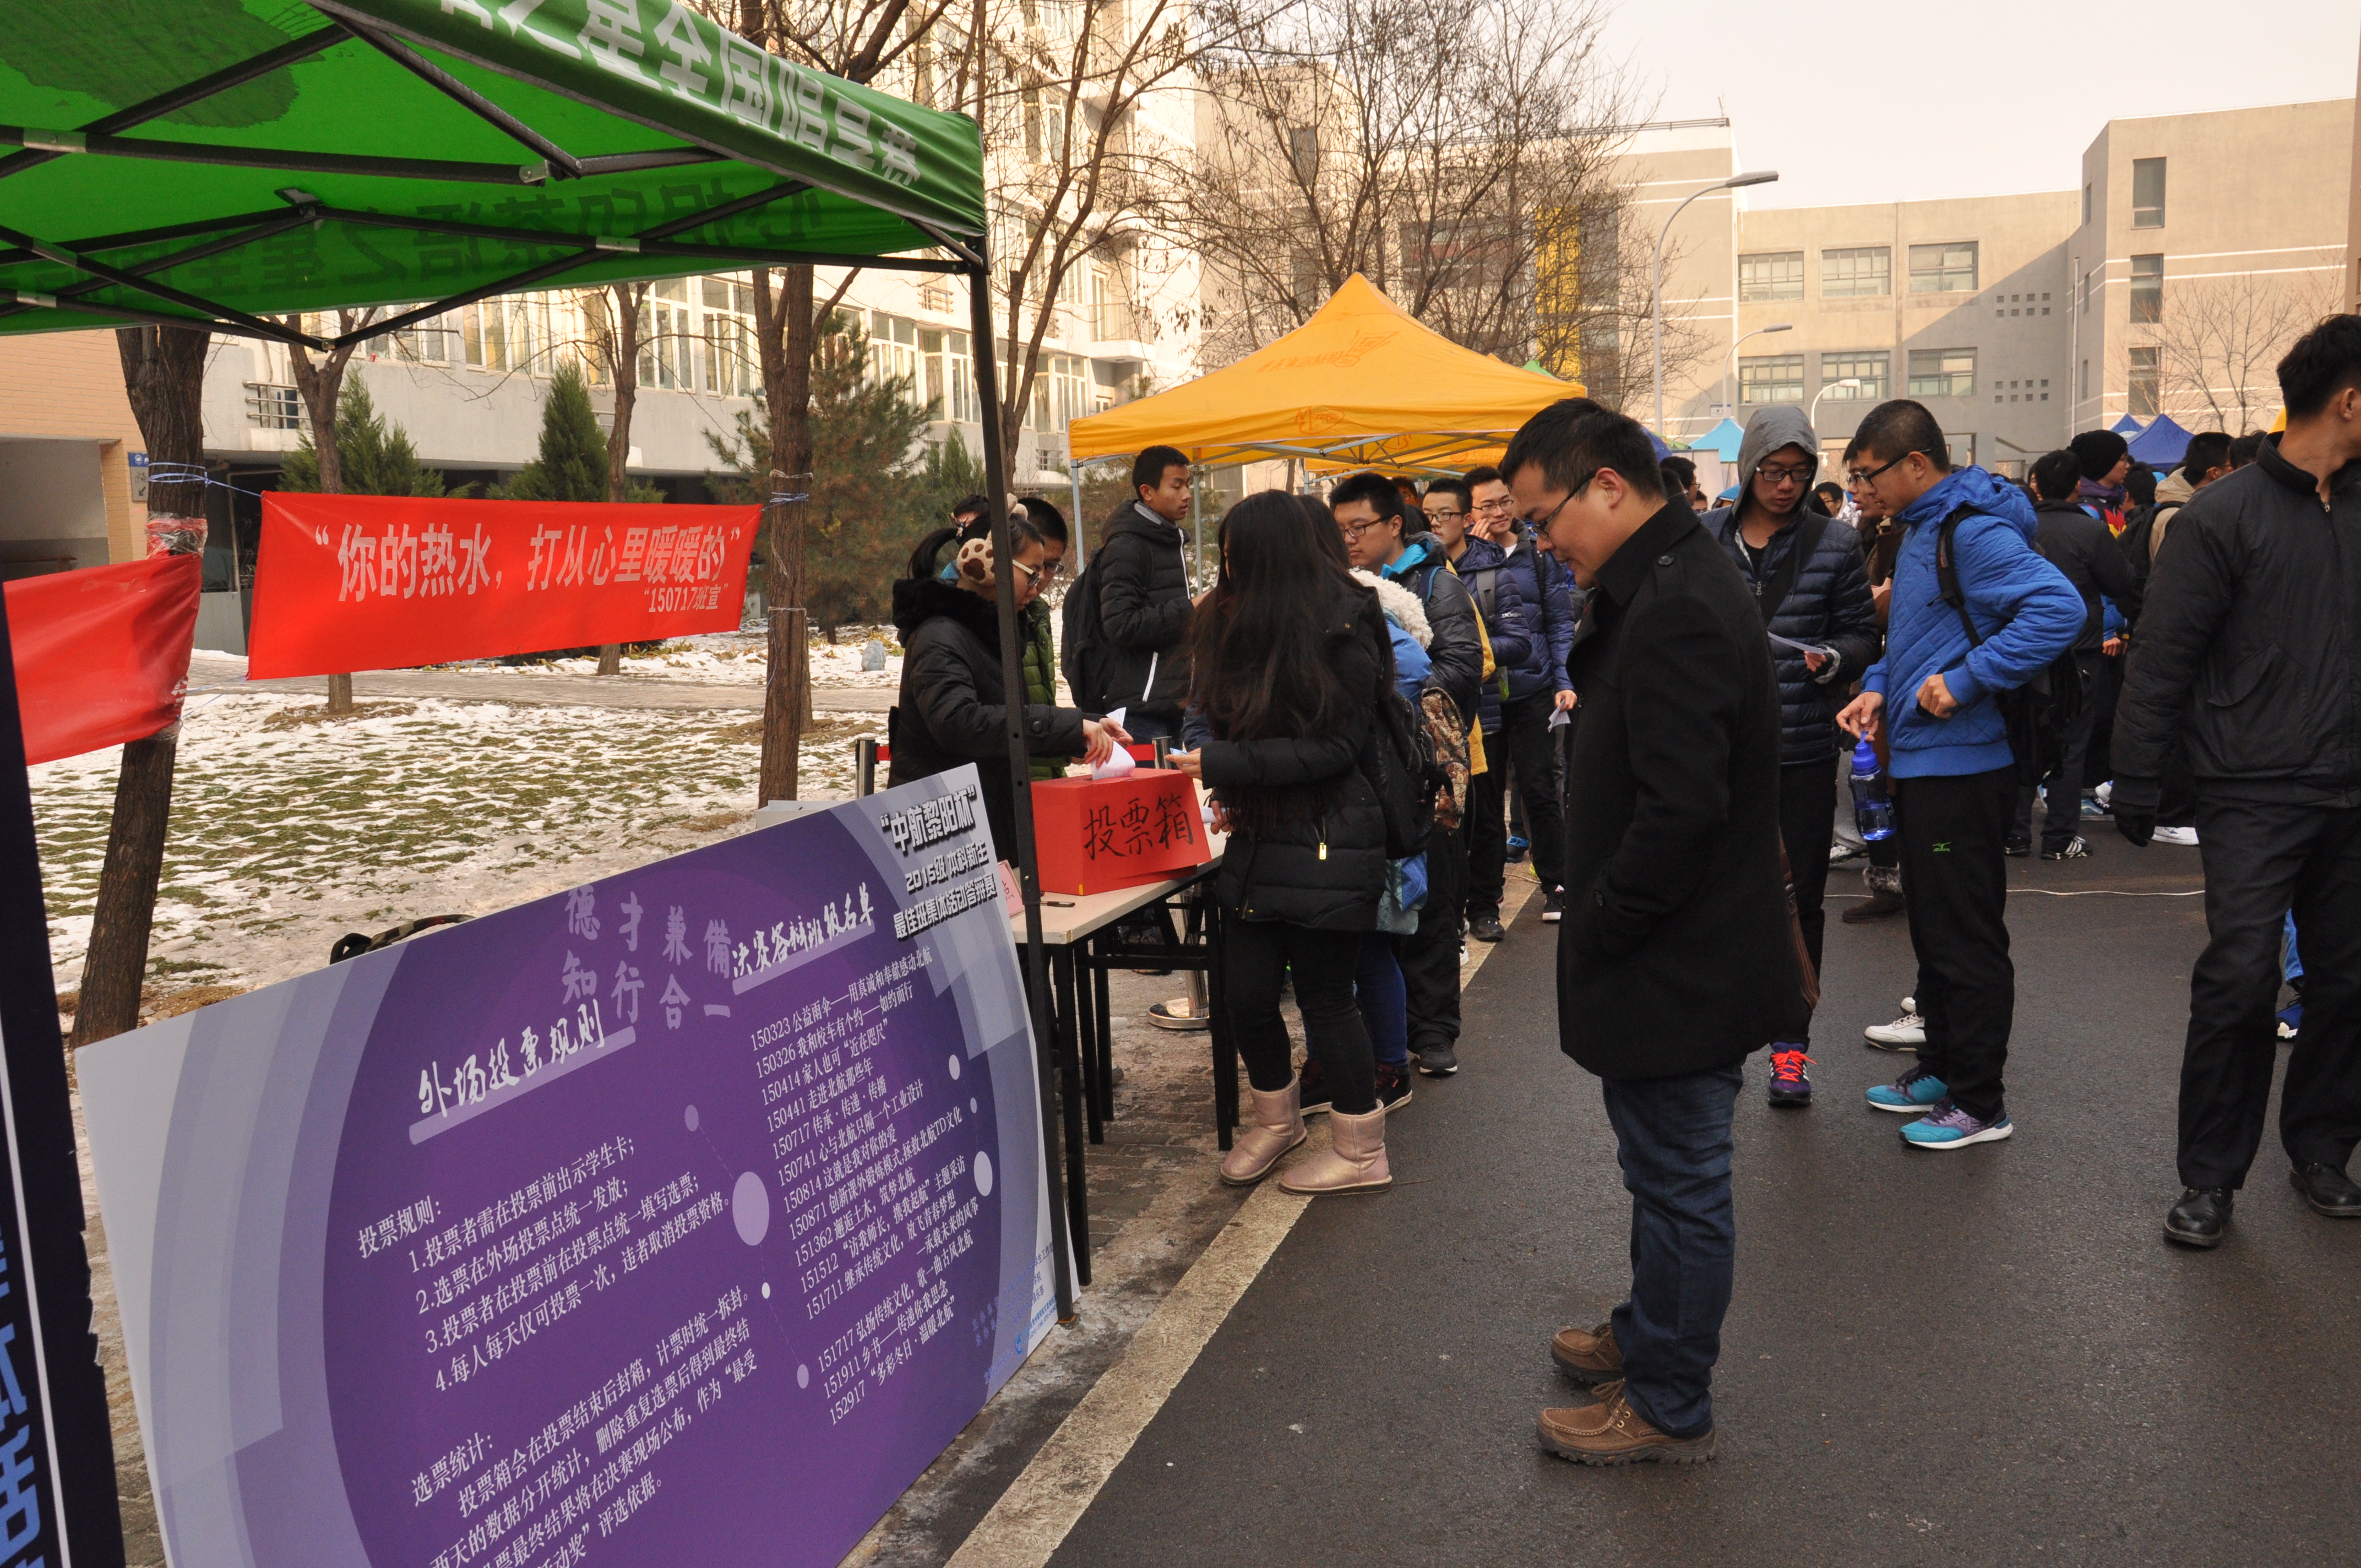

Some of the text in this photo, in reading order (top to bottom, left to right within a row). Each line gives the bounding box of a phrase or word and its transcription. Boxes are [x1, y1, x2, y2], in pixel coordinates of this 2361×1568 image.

[1084, 793, 1193, 860] 投票箱
[893, 873, 997, 939] 最佳班集体活动答辩赛
[732, 882, 873, 978] 决赛答辩班级名单
[750, 1017, 791, 1051] 150323
[418, 999, 605, 1118] 外场投票规则
[756, 1044, 796, 1078] 150326
[761, 1070, 801, 1106] 150414
[767, 1057, 873, 1133] 150441 走进北航那些年
[773, 1122, 810, 1159] 150717
[778, 1079, 924, 1186] 150741 心与北航只隔一个工业设计
[784, 1124, 897, 1213] 150814 这就是我对你的爱
[357, 1195, 442, 1259] 投票规则：
[789, 1203, 826, 1240] 150871
[796, 1227, 833, 1266] 151362
[801, 1253, 839, 1293] 151512
[807, 1279, 844, 1320] 151711
[818, 1329, 853, 1373] 151717
[824, 1356, 860, 1400] 151911
[830, 1380, 865, 1425] 152917
[411, 1433, 493, 1506] 选票统计：
